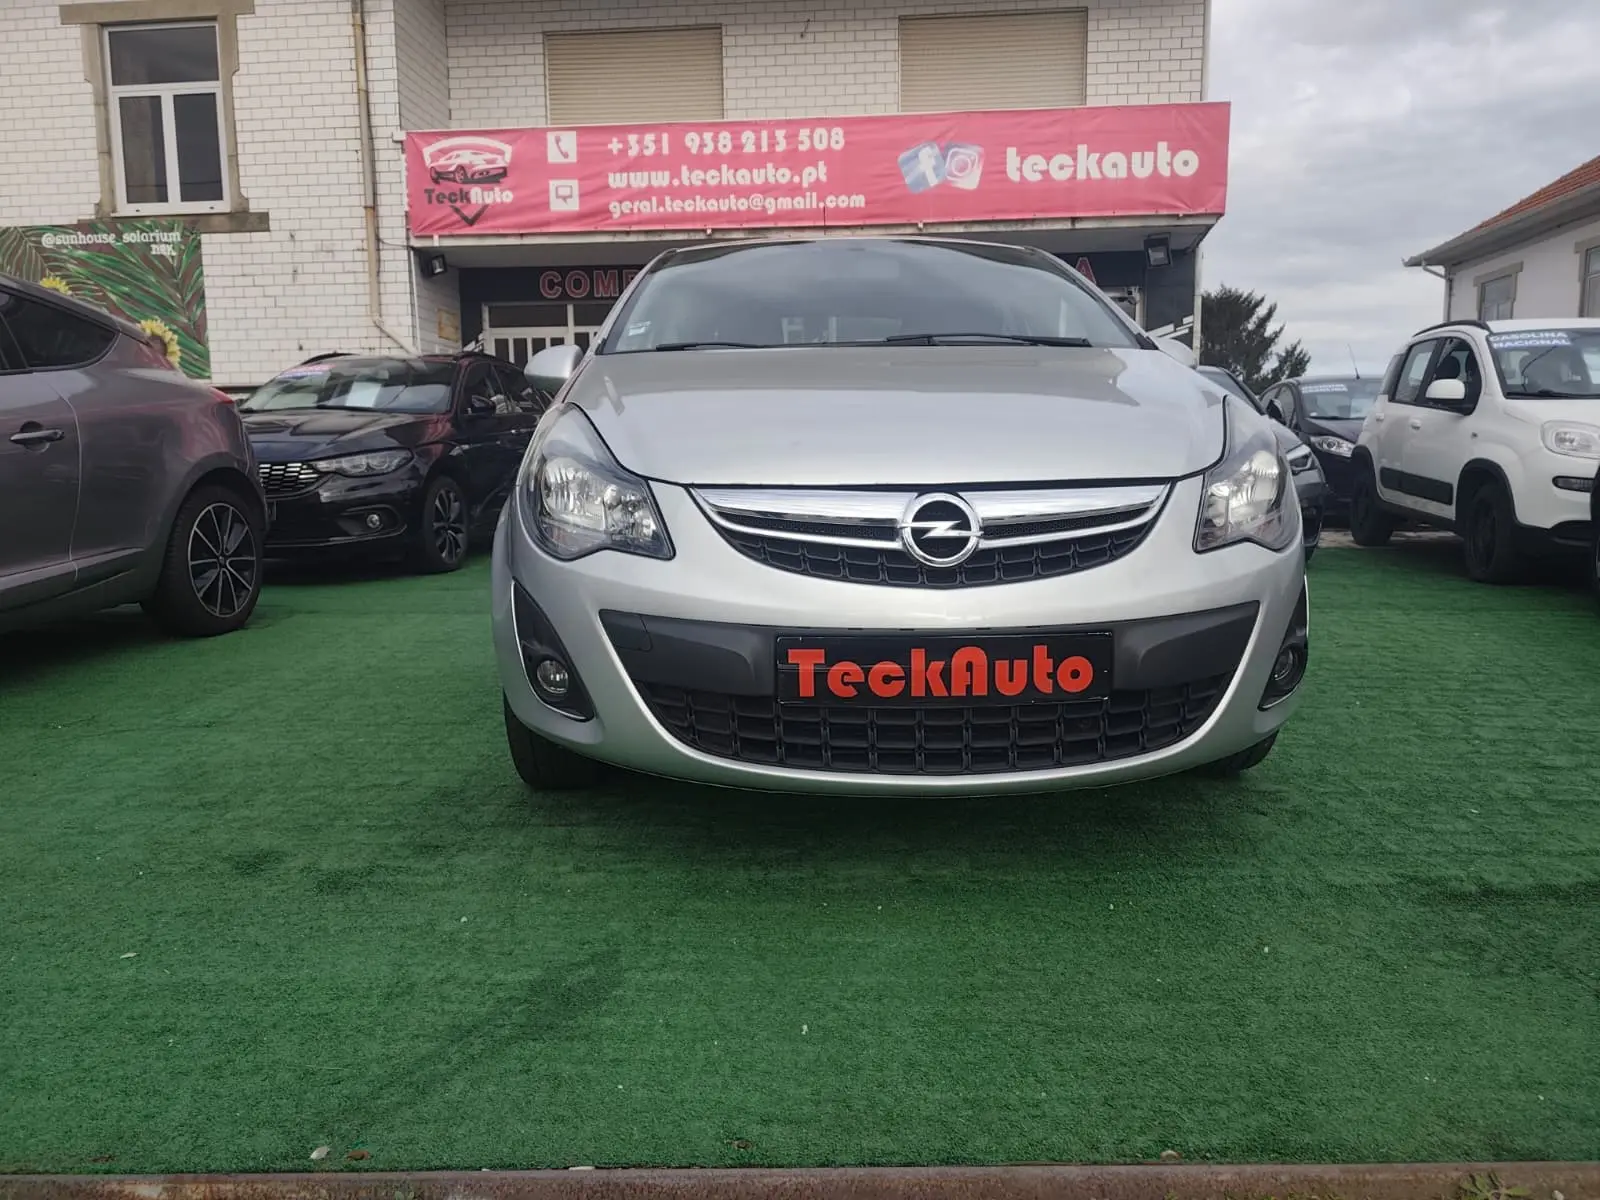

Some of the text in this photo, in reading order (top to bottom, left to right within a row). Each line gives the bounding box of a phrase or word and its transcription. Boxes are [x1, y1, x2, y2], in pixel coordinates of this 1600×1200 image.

[608, 127, 845, 157] +351 938 213 508
[608, 160, 828, 188] www.teckauto.pt
[1006, 141, 1199, 182] teckauto
[424, 186, 514, 205] TeckAuto
[608, 192, 866, 219] geral.teckauto@gmail.com
[41, 229, 182, 249] @sunhouse solarium
[787, 645, 1094, 698] TeckAuto
